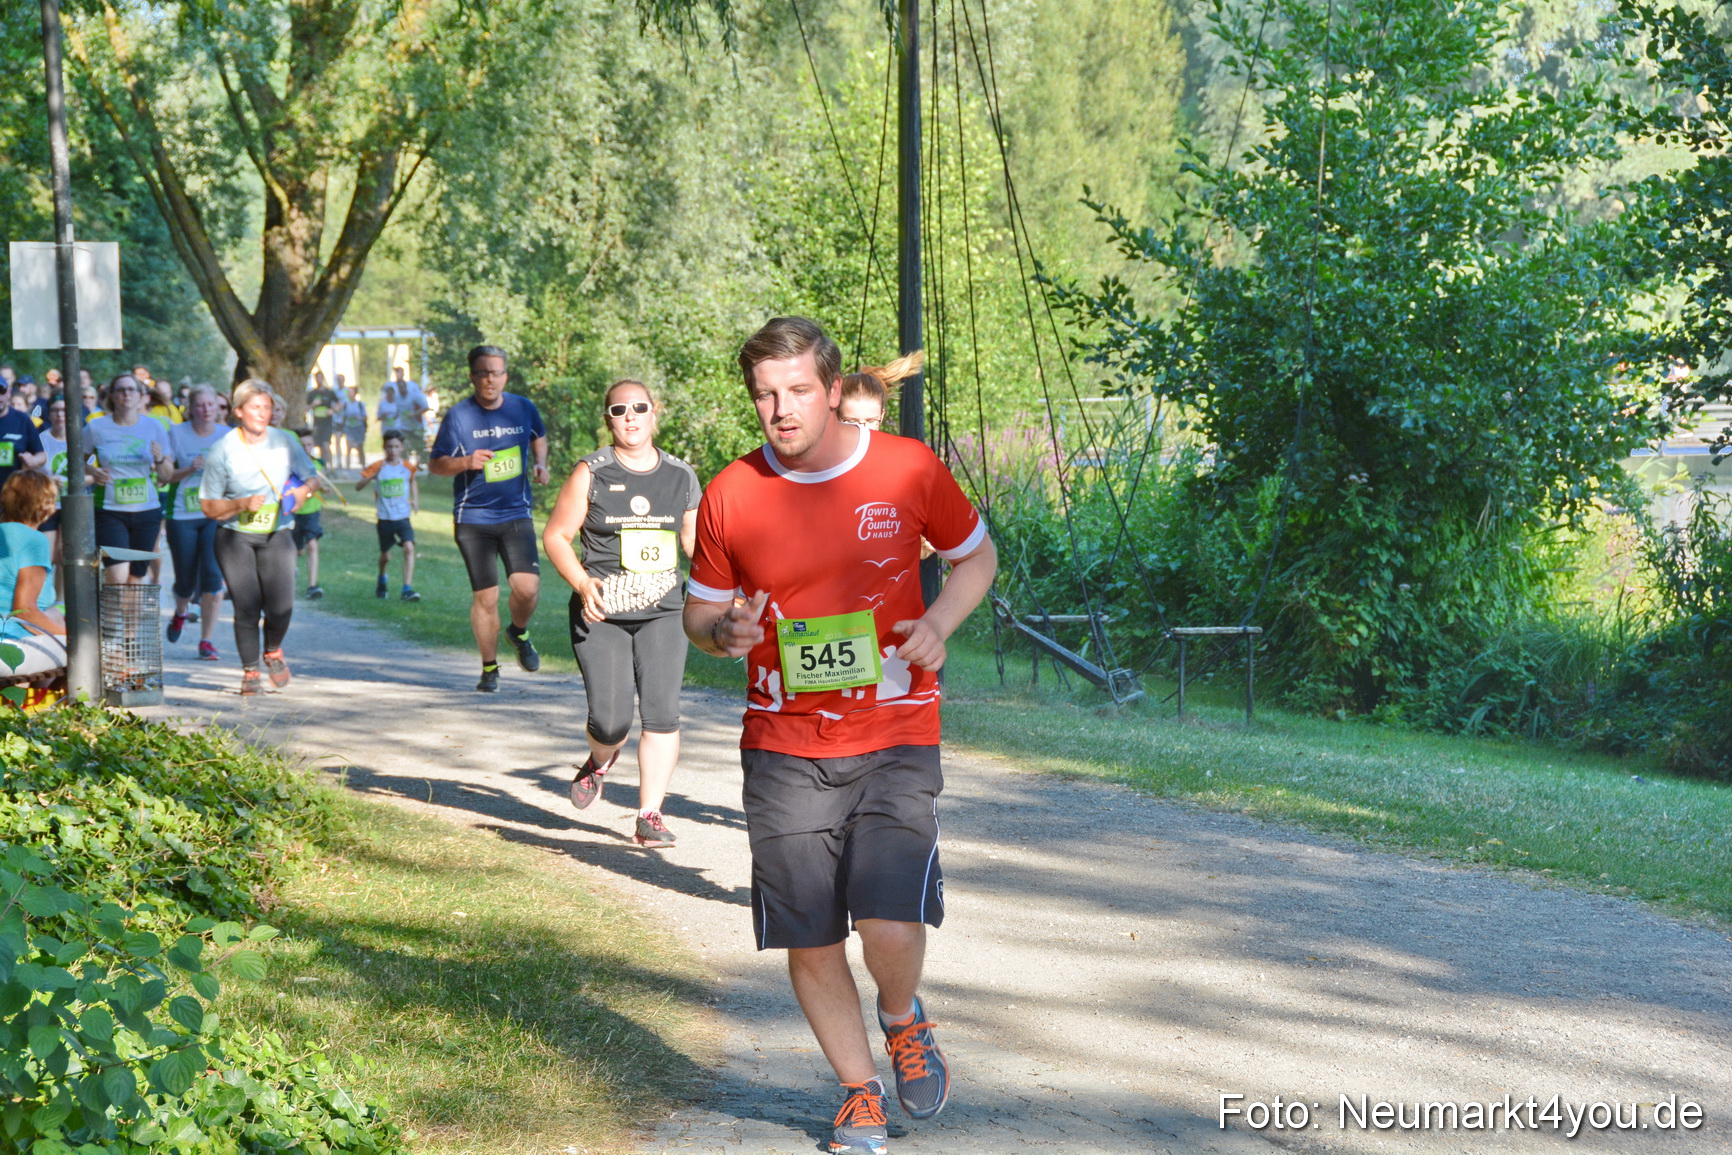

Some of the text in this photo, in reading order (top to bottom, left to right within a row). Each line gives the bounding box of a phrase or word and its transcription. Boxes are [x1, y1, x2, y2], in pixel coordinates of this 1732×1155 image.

[494, 459, 515, 473] 510
[120, 486, 144, 497] 1032
[247, 513, 270, 523] 645
[855, 502, 897, 521] Town &
[858, 517, 901, 541] Country
[640, 546, 660, 561] 63
[800, 641, 856, 671] 545
[796, 667, 866, 679] Fischer Maximilian
